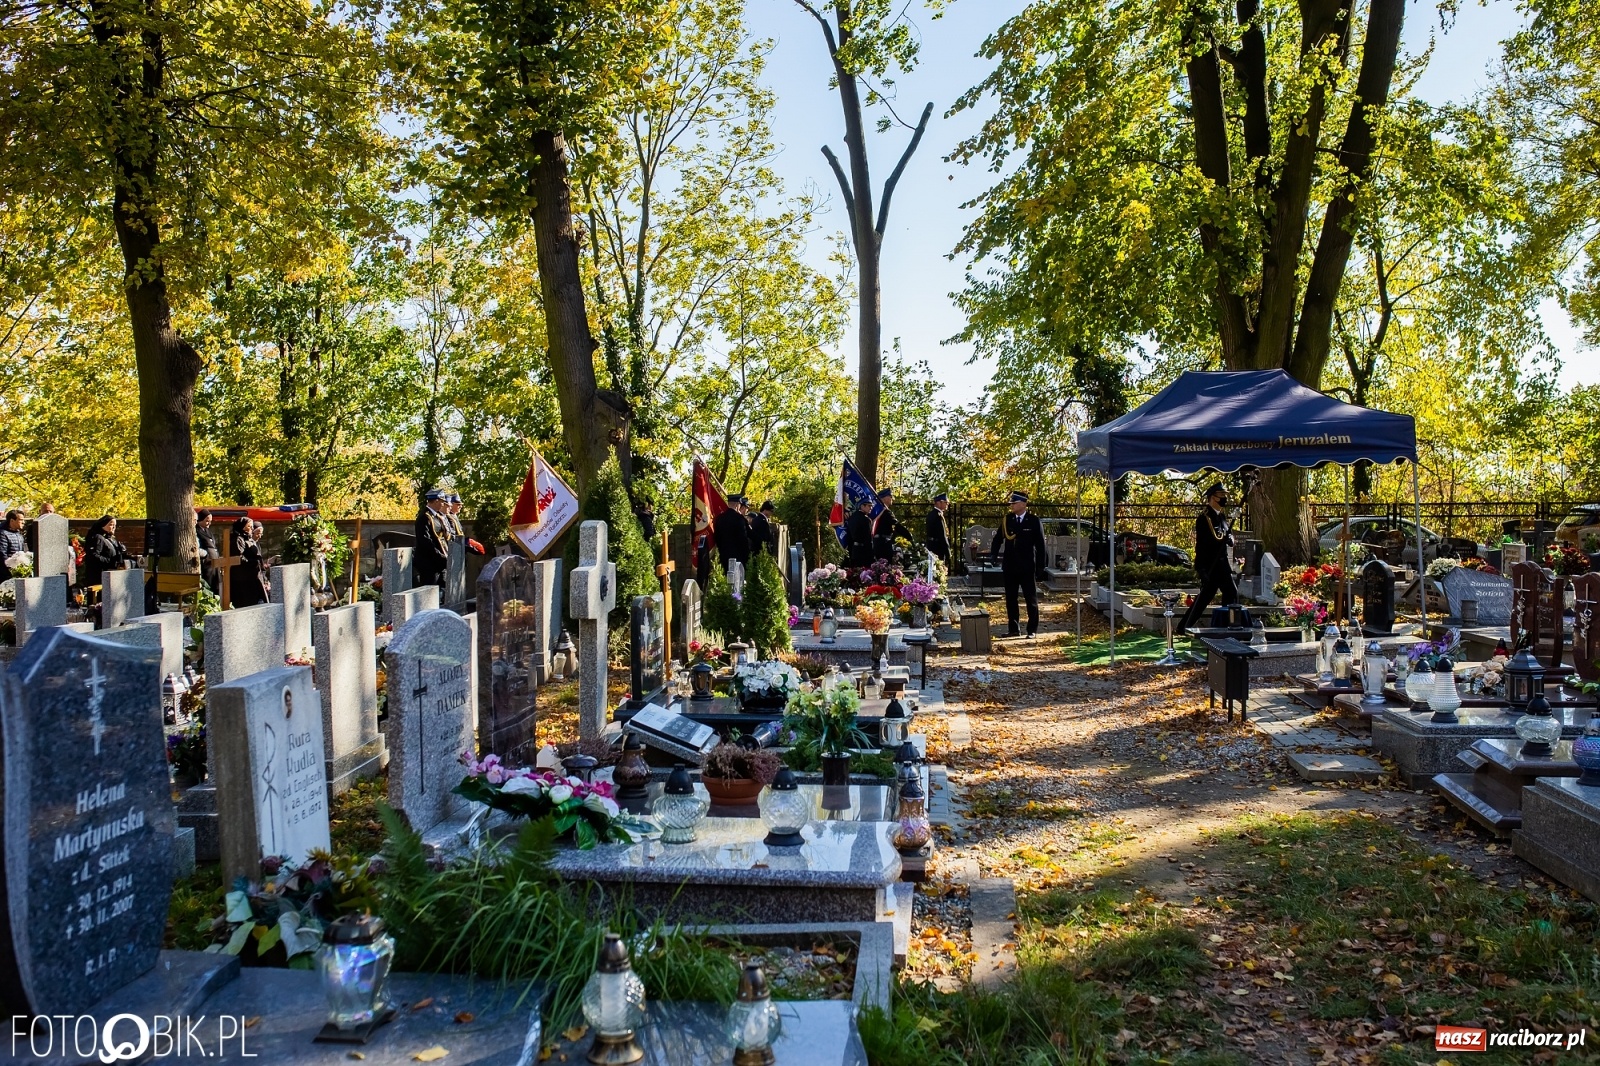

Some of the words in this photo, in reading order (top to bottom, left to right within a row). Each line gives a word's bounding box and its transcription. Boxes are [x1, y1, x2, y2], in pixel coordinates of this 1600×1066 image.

[1173, 442, 1209, 453] Zakład
[1211, 440, 1275, 453] Pogrzebowy
[1278, 433, 1352, 449] Jeruzalem
[437, 689, 467, 716] DAMEK
[76, 782, 126, 815] Helena
